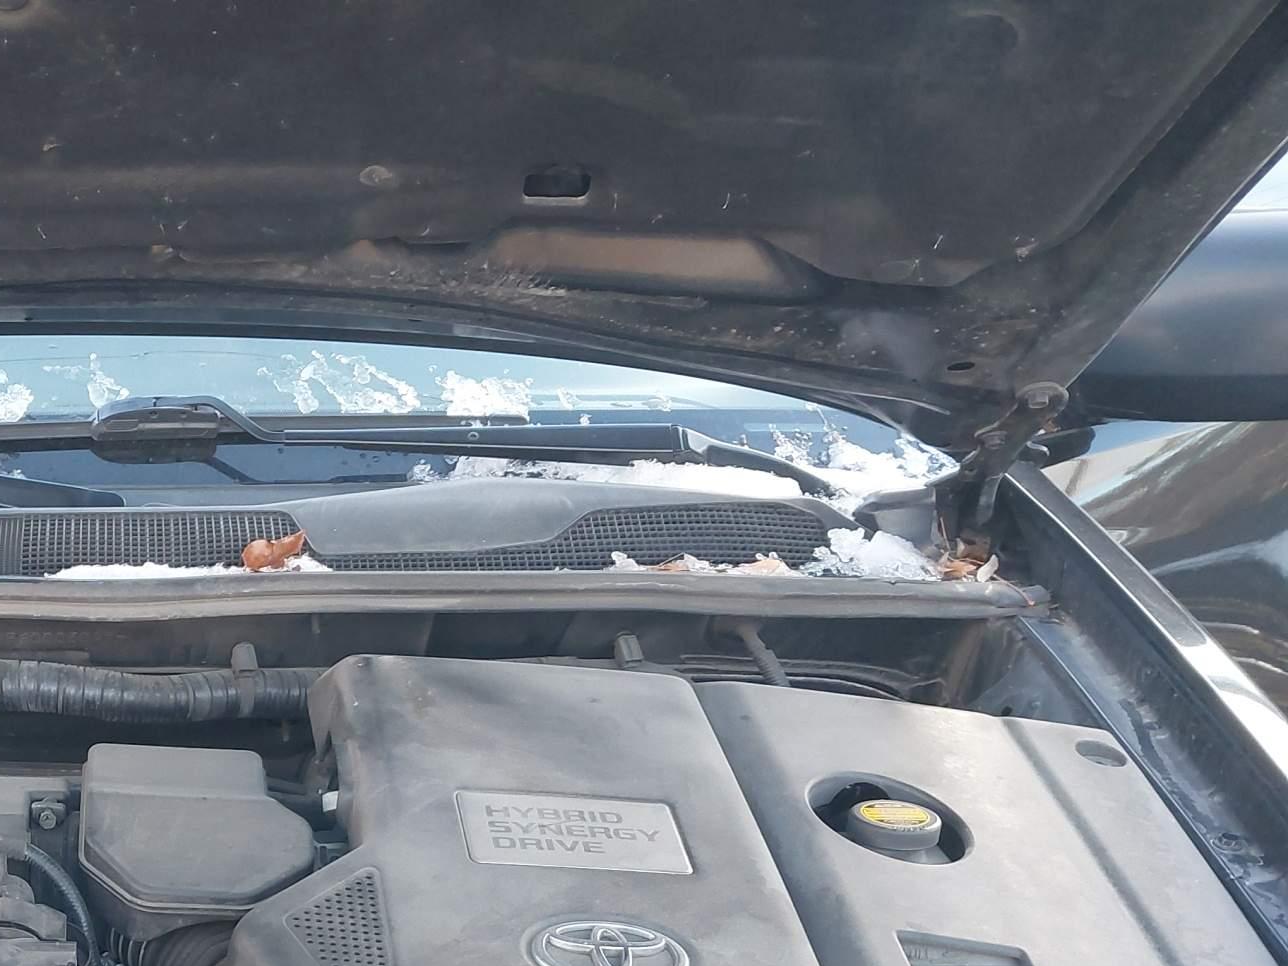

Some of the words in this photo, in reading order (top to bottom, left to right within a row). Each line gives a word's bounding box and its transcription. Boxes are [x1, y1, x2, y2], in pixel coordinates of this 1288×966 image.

[485, 804, 623, 824] HYBRID
[487, 820, 659, 842] SYNERGY
[491, 836, 606, 854] DRIVE
